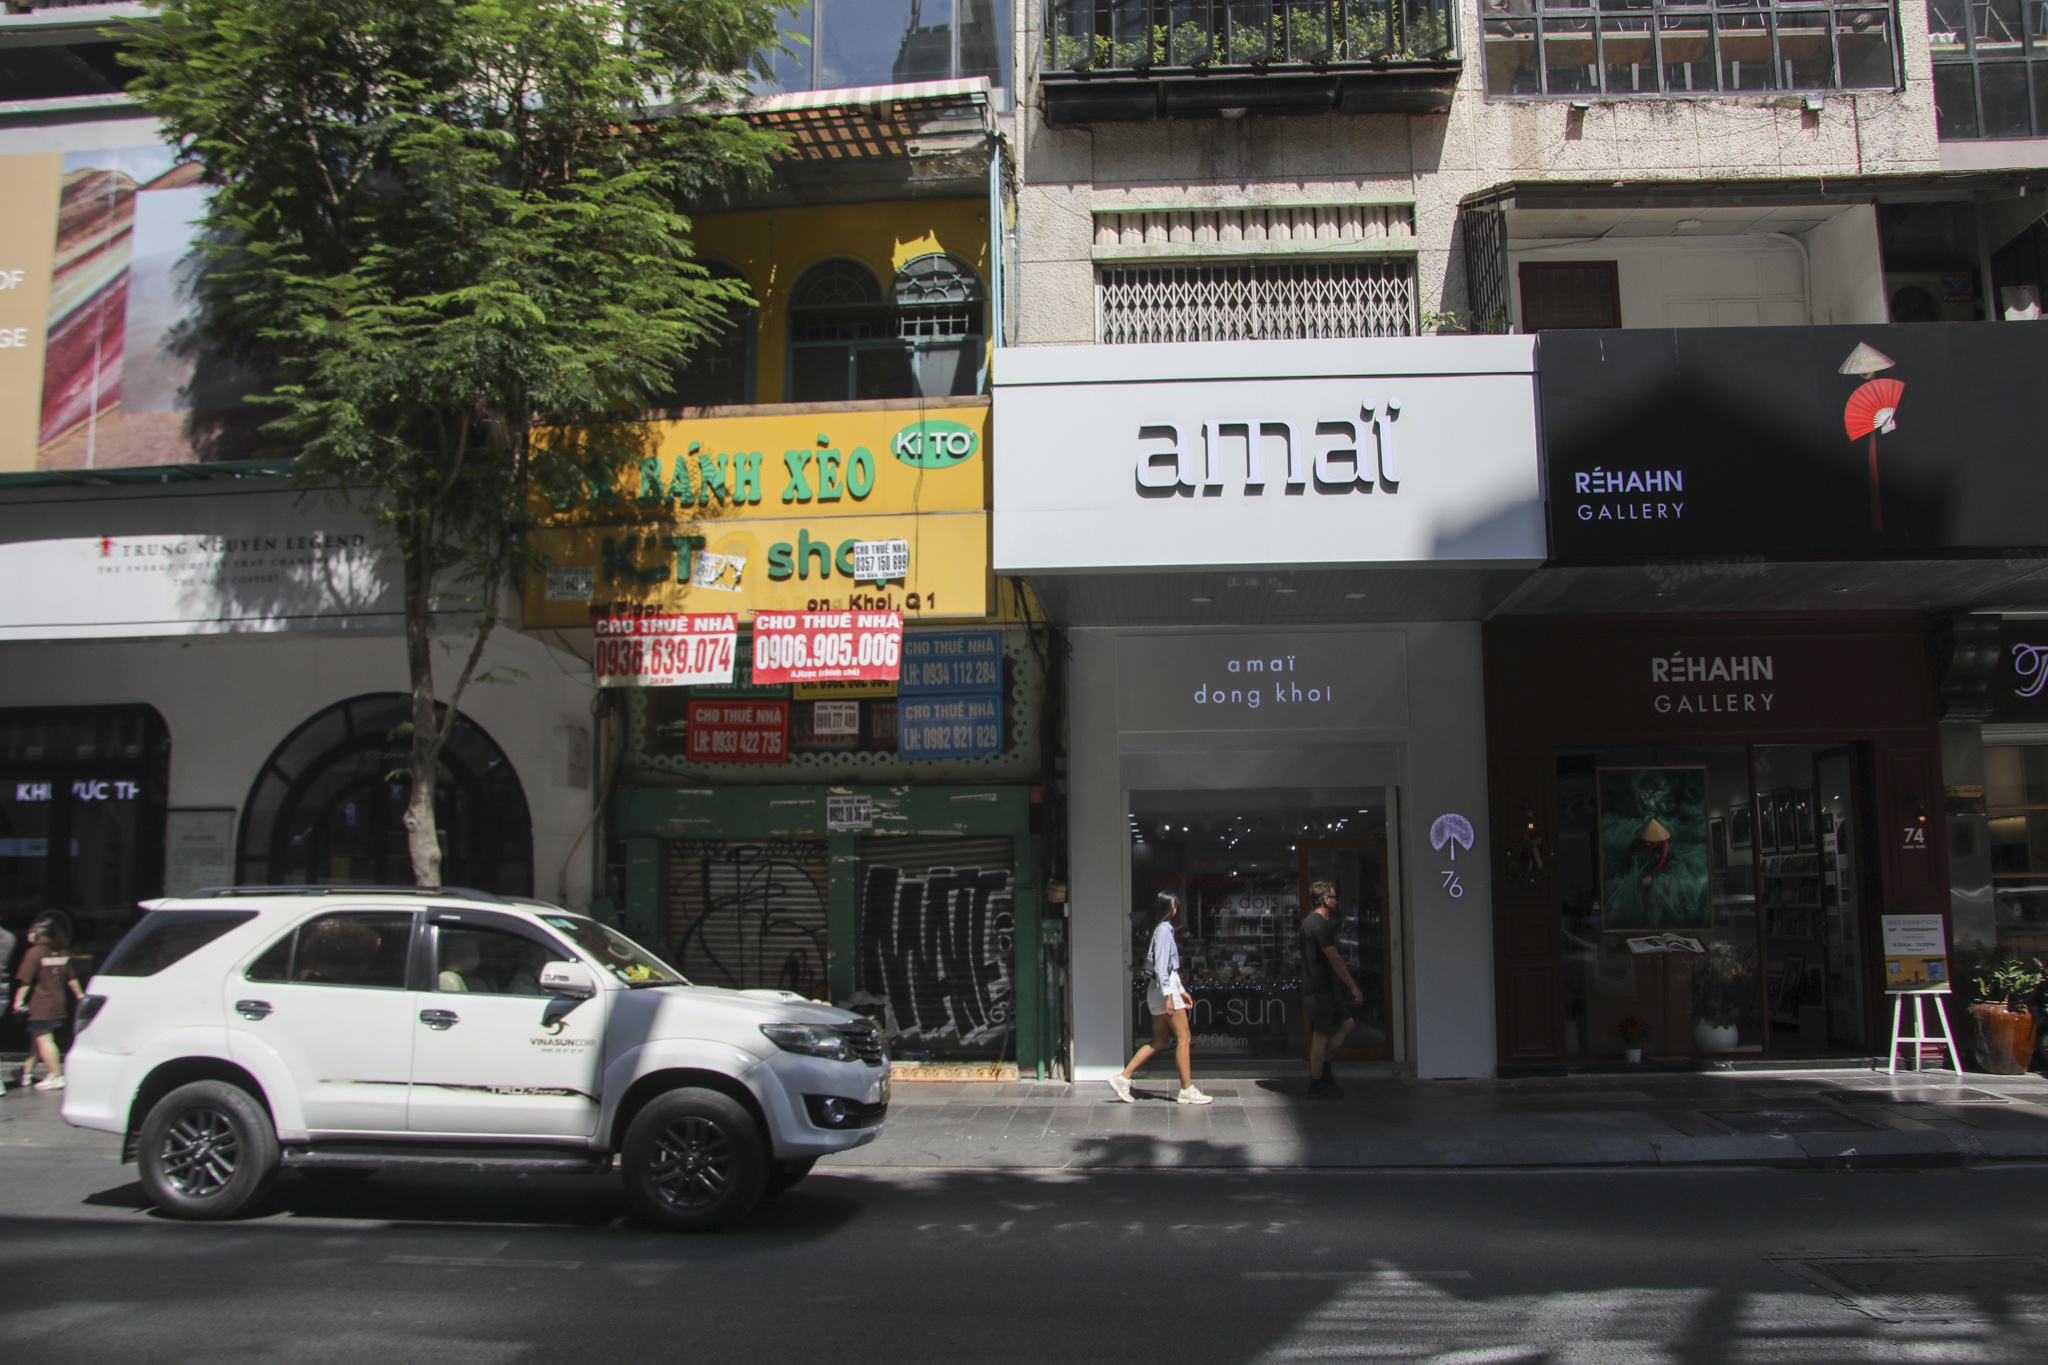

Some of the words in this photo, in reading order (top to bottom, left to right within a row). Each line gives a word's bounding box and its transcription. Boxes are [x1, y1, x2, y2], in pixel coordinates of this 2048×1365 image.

[1137, 396, 1402, 494] amaï
[638, 441, 764, 507] BÁNH
[782, 433, 876, 503] XÈO
[1574, 466, 1685, 494] RÉHAHN
[1577, 502, 1685, 521] GALLERY
[123, 543, 187, 557] TRUNG
[199, 535, 277, 554] NGUYÊN
[285, 534, 366, 550] LEGEND
[855, 545, 870, 556] CHO
[871, 543, 890, 555] THUÊ
[892, 542, 907, 554] NHÀ
[855, 556, 875, 572] 0357
[877, 555, 891, 571] 150
[596, 618, 635, 634] CHO
[640, 615, 690, 633] THUÊ
[694, 614, 735, 632] NHÀ
[756, 615, 797, 630] CHO
[802, 612, 853, 629] THUÊ
[857, 612, 902, 629] NHÀ
[595, 637, 731, 677] 0936.639.074
[755, 632, 900, 670] 0906.905.006
[905, 641, 930, 655] CHO
[933, 637, 964, 654] THUÊ
[967, 637, 994, 653] NHÀ
[903, 663, 920, 686] LH:
[922, 662, 950, 686] 0934
[952, 661, 974, 684] 112
[975, 661, 997, 684] 284
[1227, 655, 1296, 673] amaï
[1650, 650, 1774, 682] RÉHAHN
[1193, 682, 1261, 709] dong
[1275, 681, 1332, 703] khoi
[1653, 692, 1775, 714] GALLERY
[695, 708, 721, 723] CHO
[723, 706, 753, 723] THUÊ
[756, 706, 783, 723] NHÀ
[905, 704, 931, 719] CHO
[934, 701, 965, 718] THUÊ
[969, 700, 995, 717] NHÀ
[693, 730, 710, 753] LH:
[711, 730, 738, 754] 0933
[739, 731, 761, 754] 422
[761, 730, 783, 754] 735
[904, 728, 921, 751] LH:
[923, 727, 951, 750] 0982
[953, 726, 973, 749] 821
[976, 725, 997, 748] 829
[1903, 827, 1926, 844] 74
[1441, 870, 1465, 898] 76
[1238, 890, 1281, 910] dots
[1198, 1033, 1249, 1048] 9:00pm
